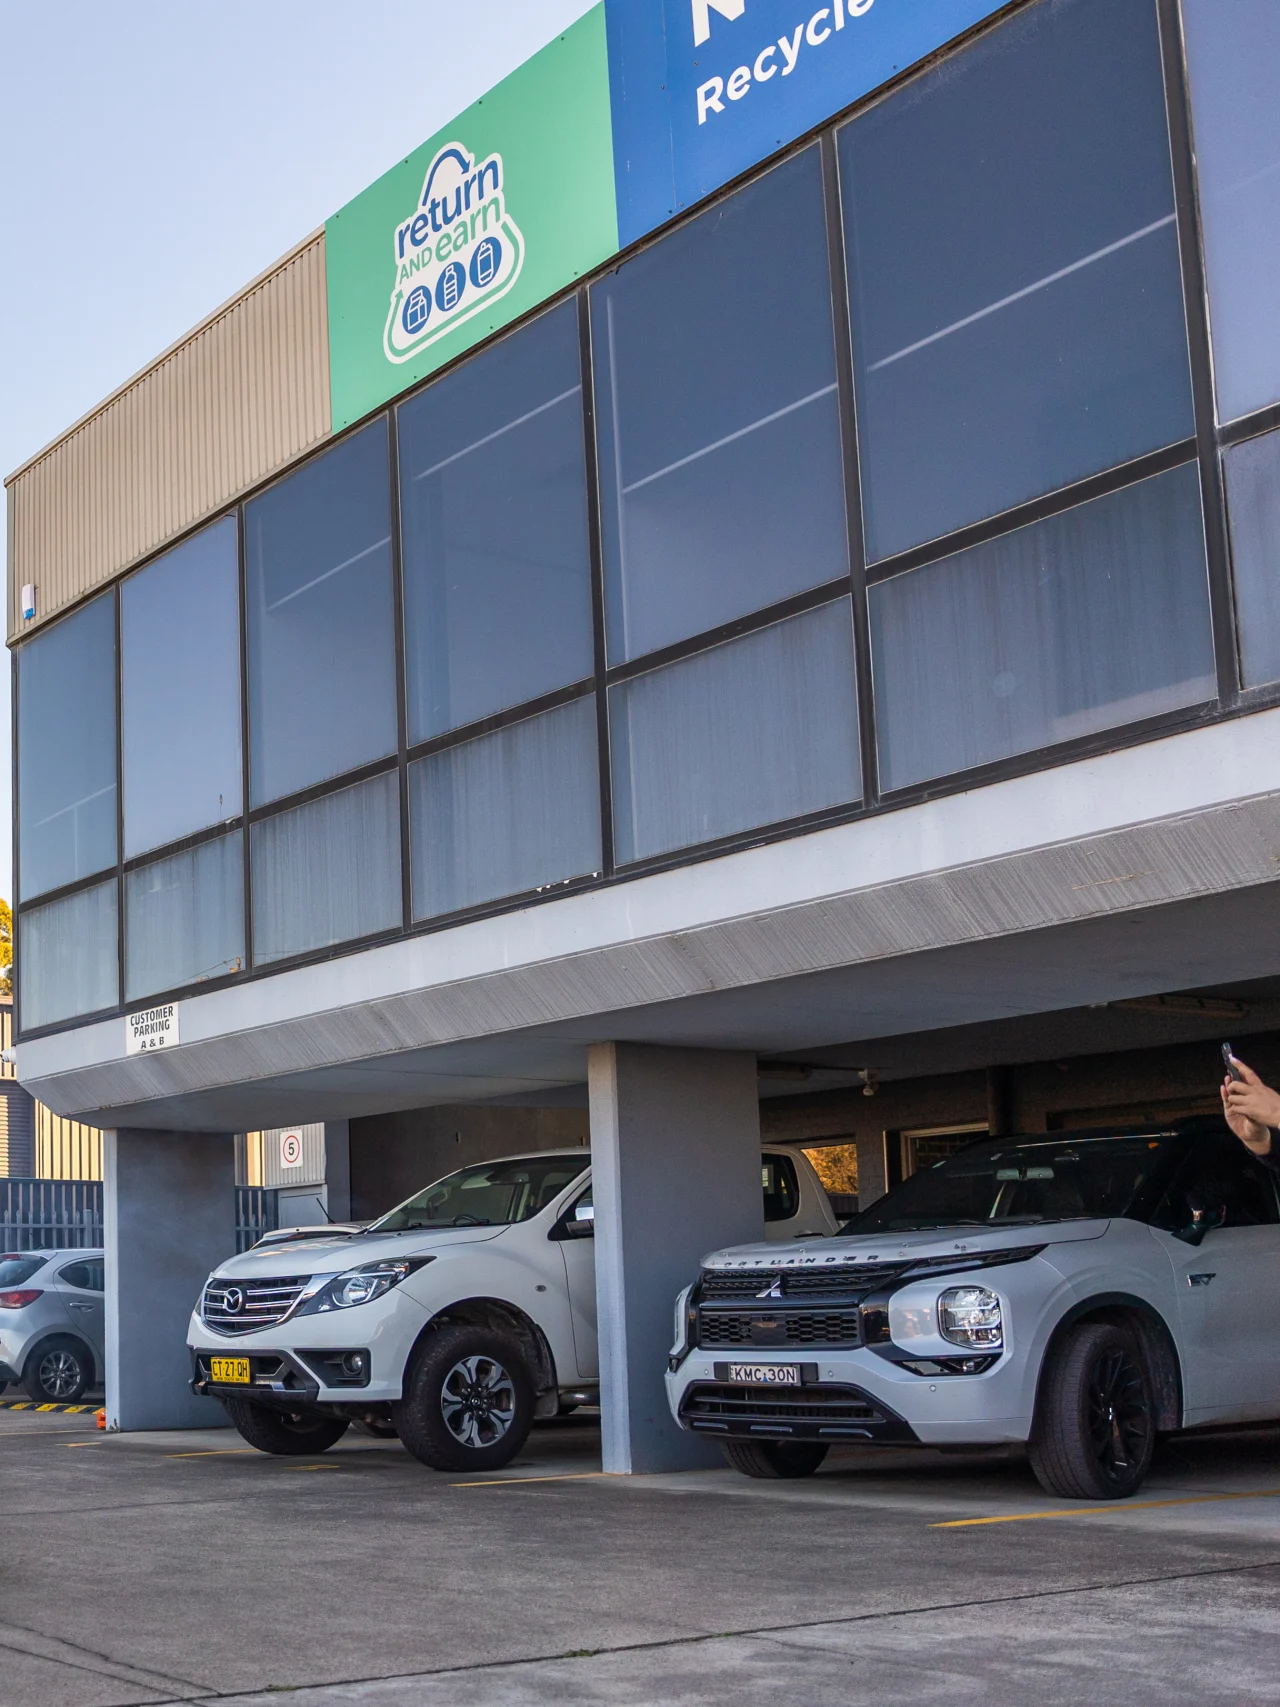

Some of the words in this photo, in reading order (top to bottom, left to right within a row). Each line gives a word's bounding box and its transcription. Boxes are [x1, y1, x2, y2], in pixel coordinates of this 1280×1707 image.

[398, 160, 499, 259] return
[399, 246, 433, 284] AND
[435, 196, 501, 262] earn
[130, 1005, 174, 1026] CUSTOMER
[133, 1019, 170, 1038] PARKING
[140, 1040, 147, 1049] A
[149, 1038, 156, 1047] &
[159, 1036, 165, 1045] B
[288, 1142, 295, 1156] 5
